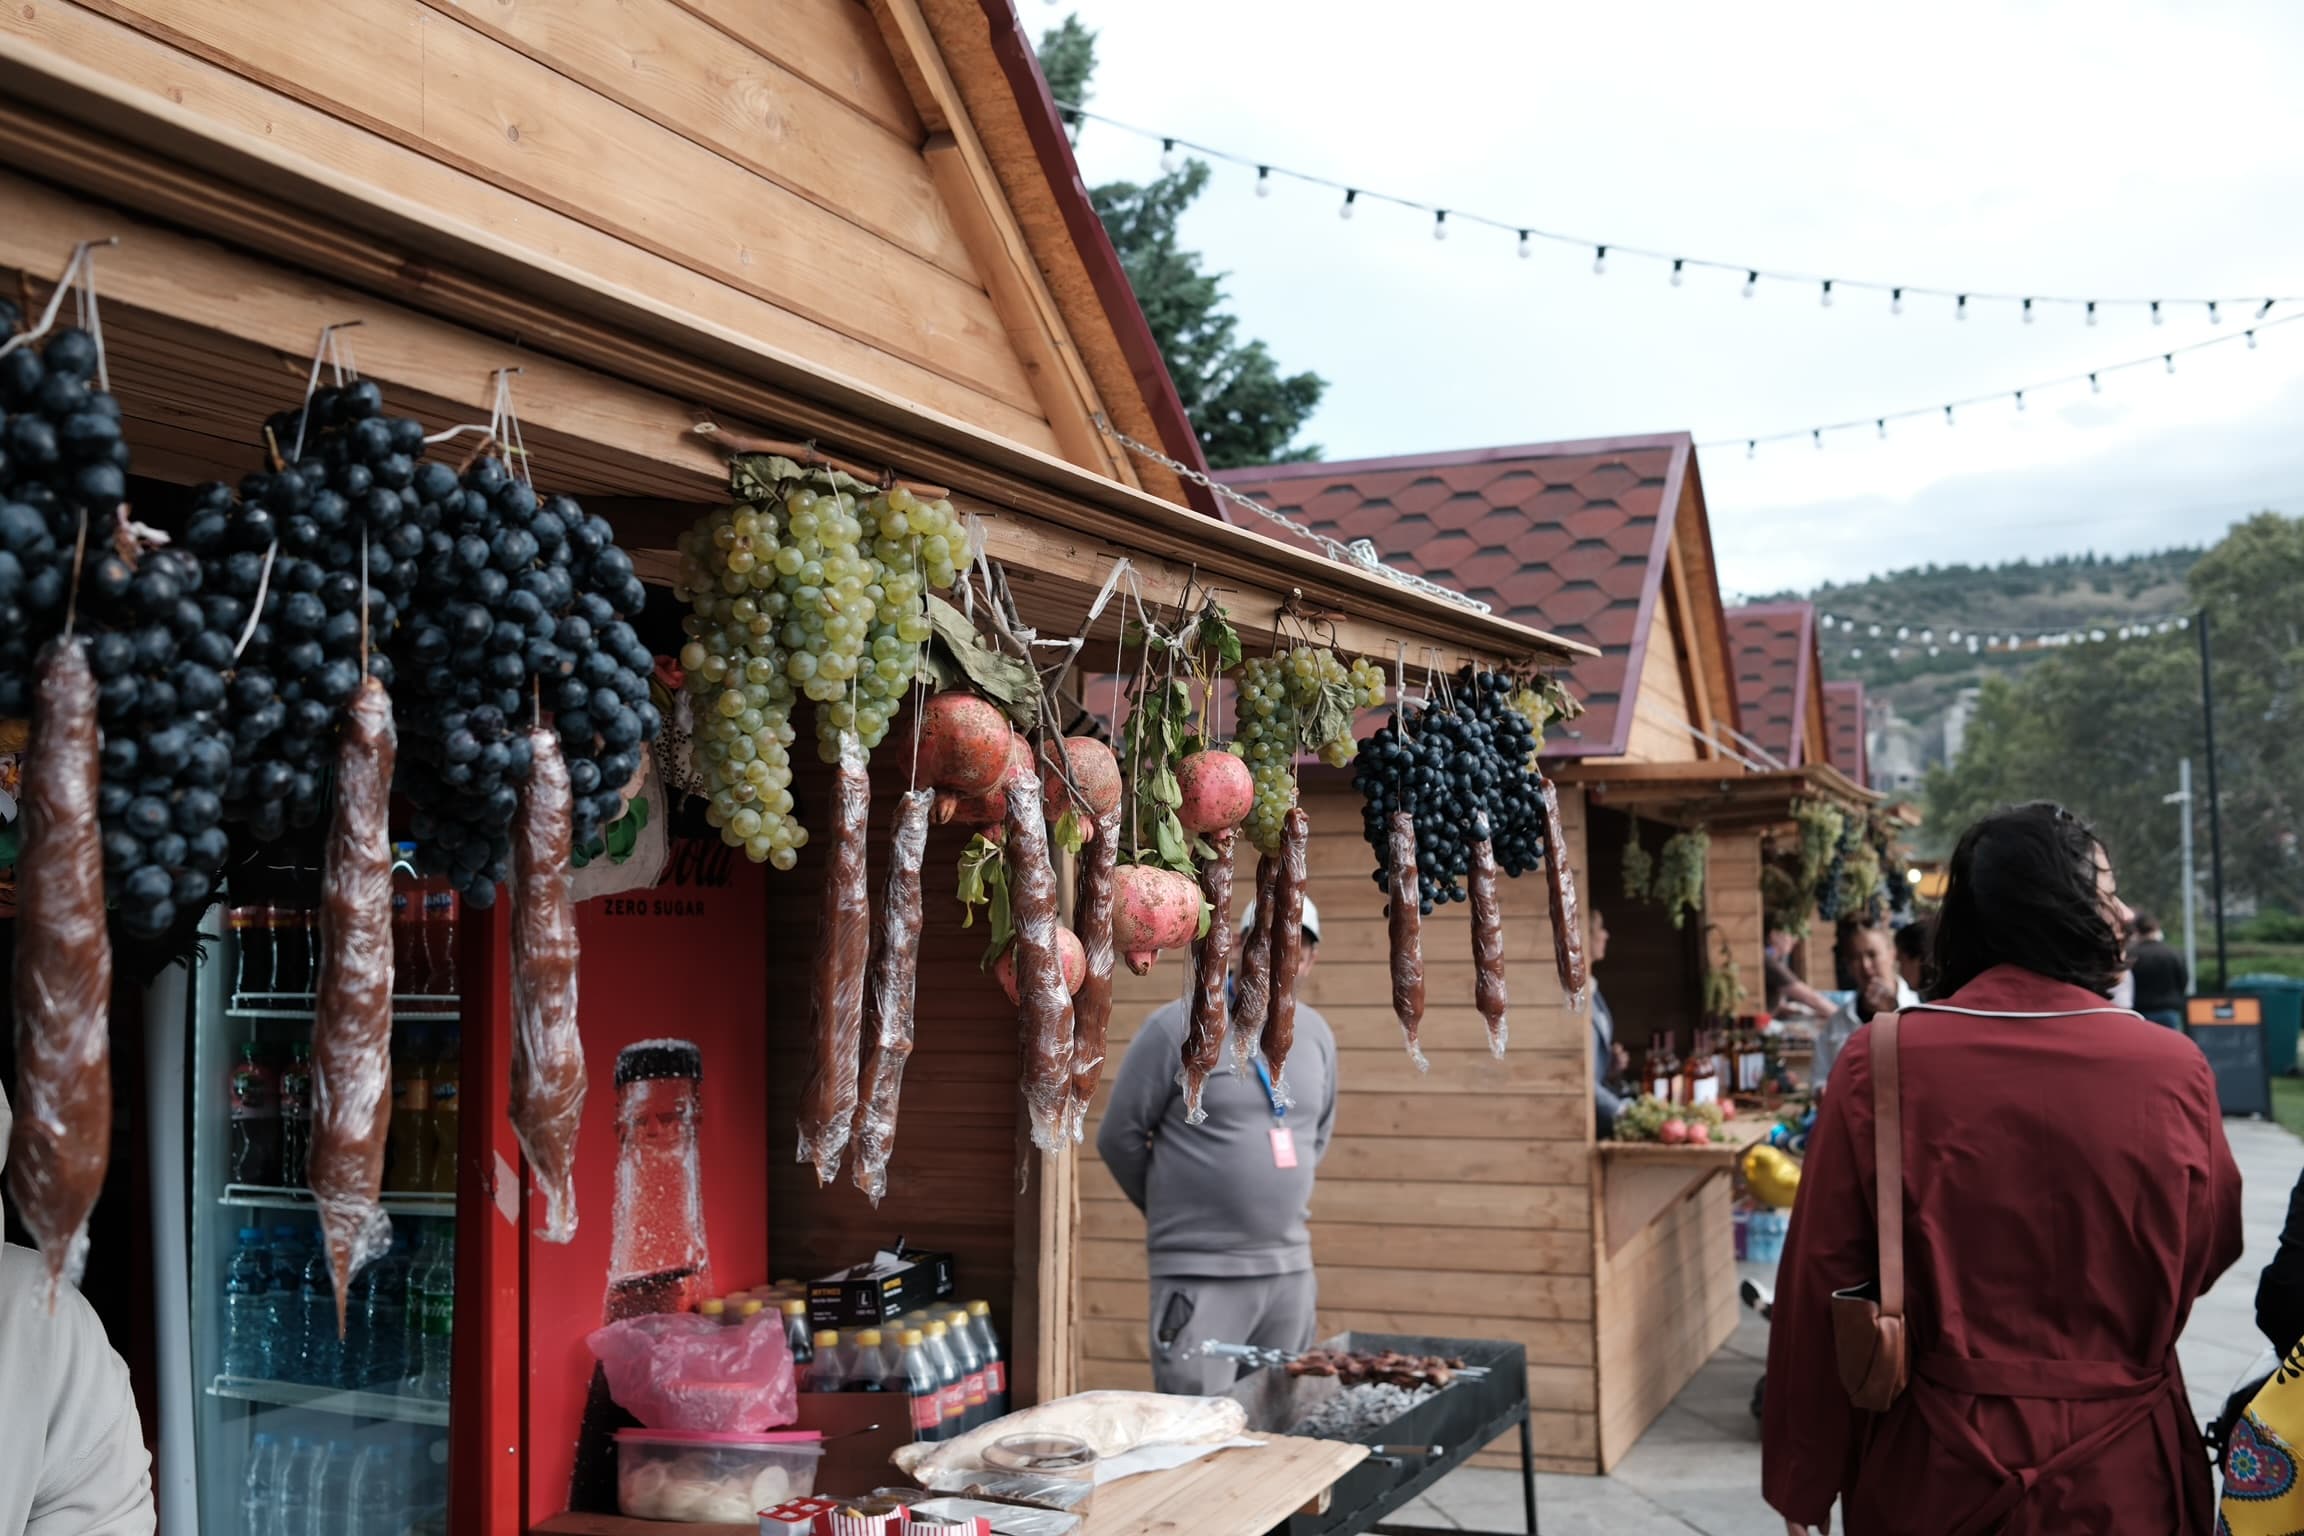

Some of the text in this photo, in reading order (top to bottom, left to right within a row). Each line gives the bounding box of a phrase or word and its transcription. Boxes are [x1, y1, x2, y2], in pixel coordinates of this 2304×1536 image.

[657, 838, 731, 888] ola
[604, 899, 704, 916] ZERO SUGAR
[860, 1292, 869, 1305] L
